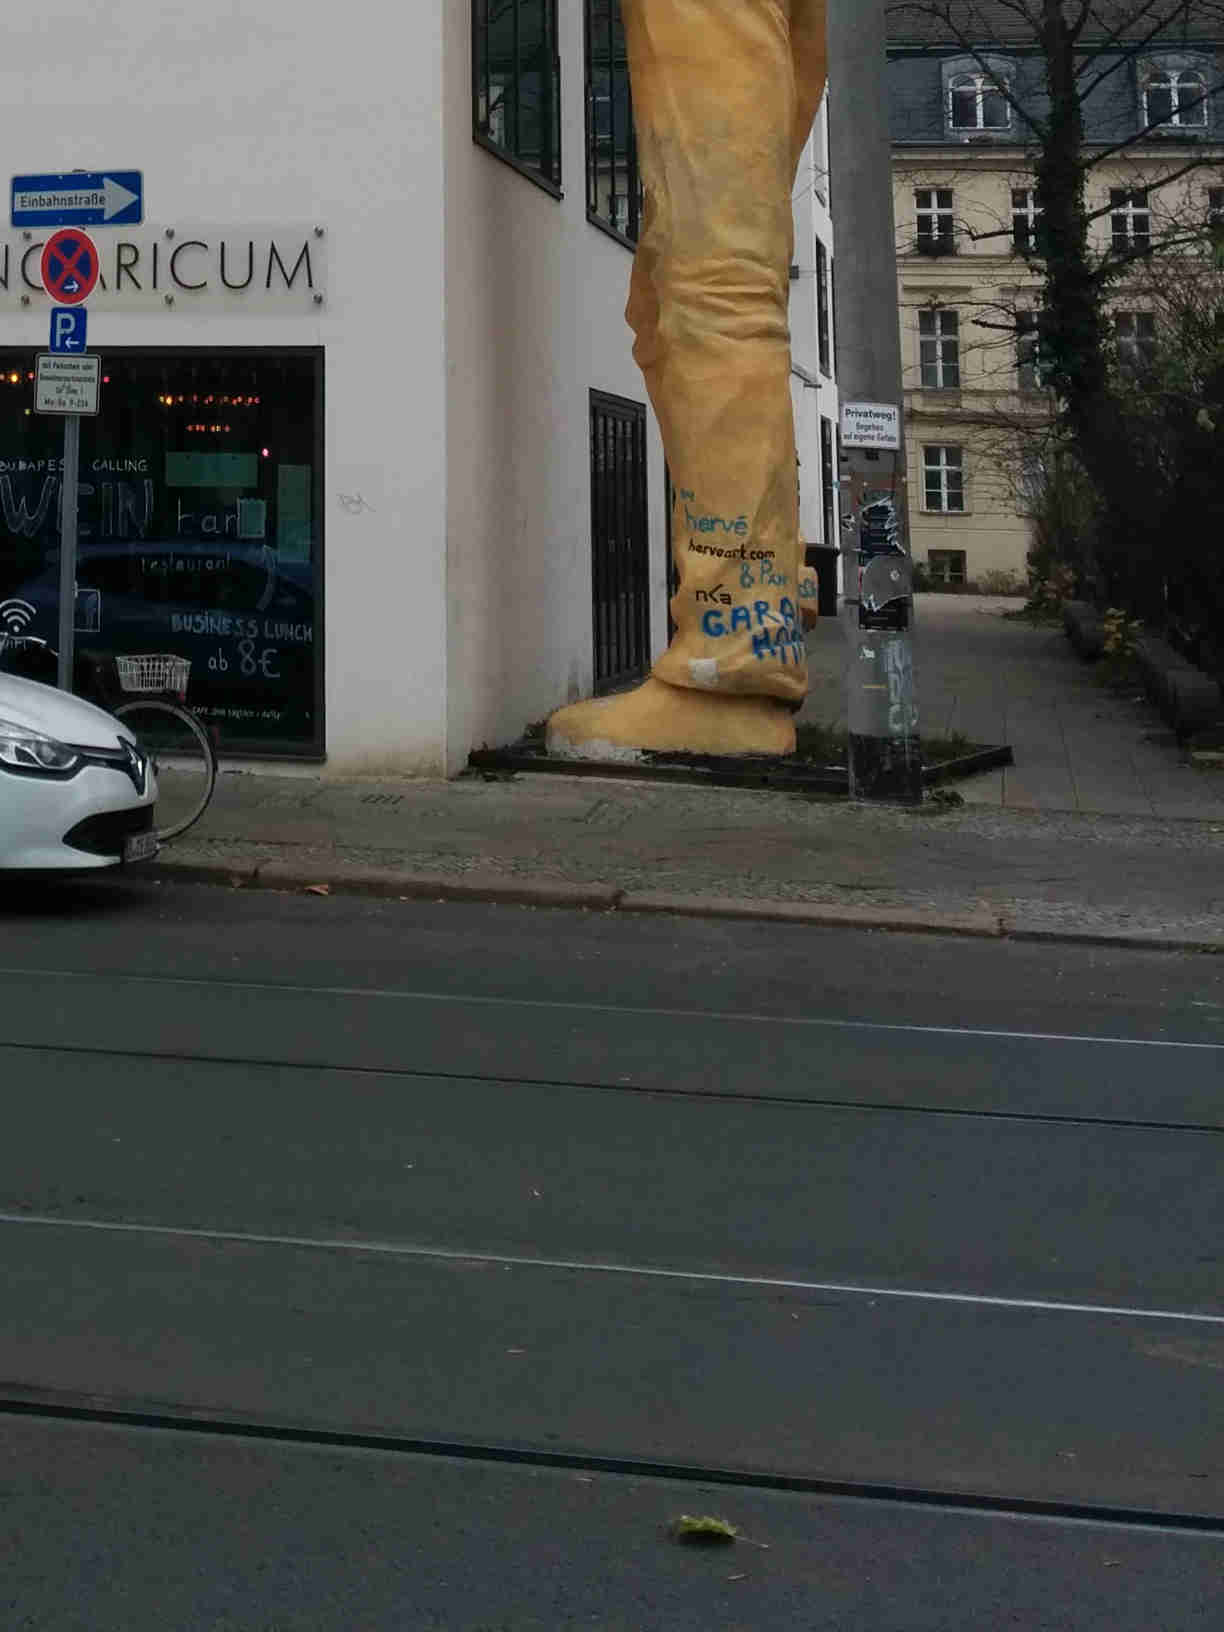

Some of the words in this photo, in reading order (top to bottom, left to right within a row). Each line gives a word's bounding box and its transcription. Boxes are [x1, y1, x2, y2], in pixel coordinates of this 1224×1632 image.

[19, 192, 106, 209] Einbahnstraße
[55, 312, 76, 348] P
[844, 408, 897, 422] Privatweg!
[0, 459, 66, 472] BUDAPES
[92, 459, 148, 472] CALLING
[263, 618, 313, 642] LUNCH
[208, 648, 229, 672] ab
[238, 639, 281, 679] 8€
